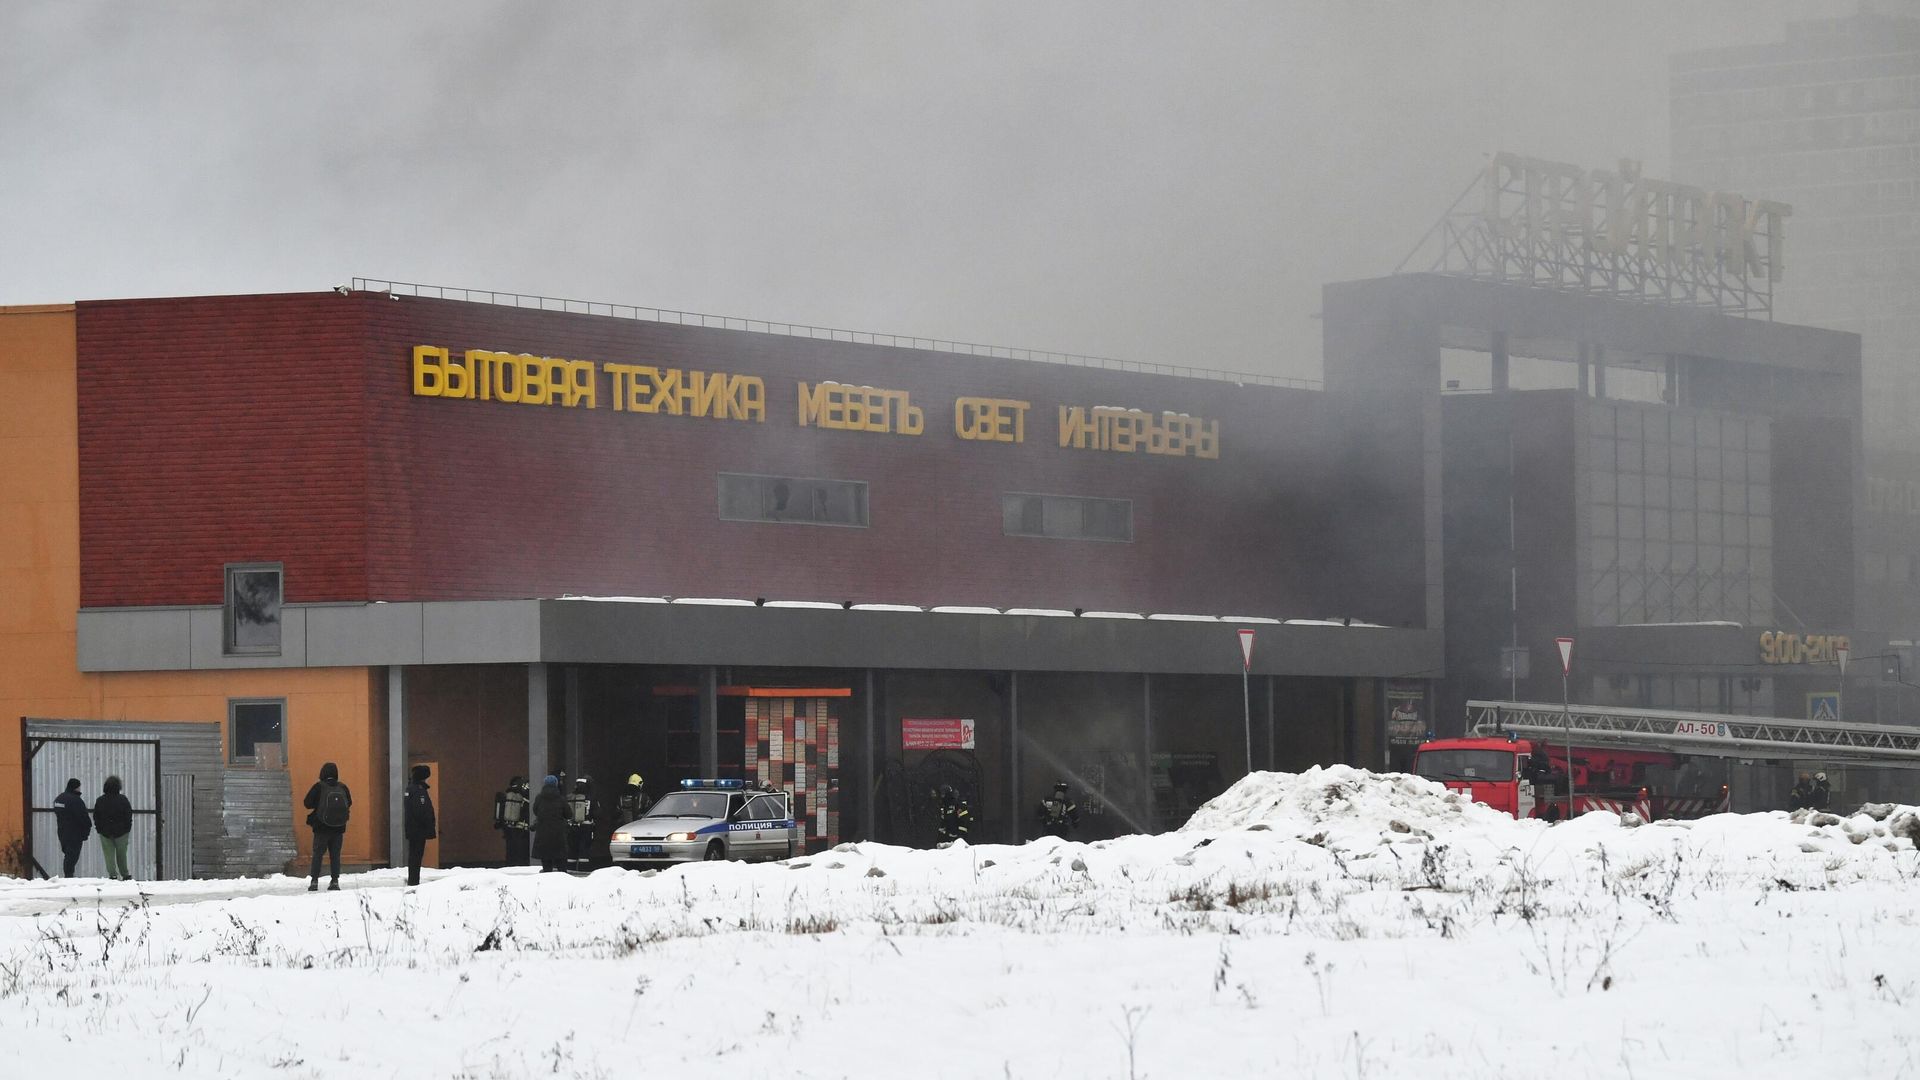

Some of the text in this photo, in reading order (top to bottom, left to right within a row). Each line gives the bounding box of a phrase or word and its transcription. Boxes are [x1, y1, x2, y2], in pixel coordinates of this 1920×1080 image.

[413, 345, 1220, 460] БЫТОВАЯ ТЕХНИКА МЕБЕЛЬ СВЕТ ИНТЕРЬЕРЫ
[1677, 722, 1716, 735] АЛ-50
[728, 821, 773, 832] ПОЛИЦИЯ
